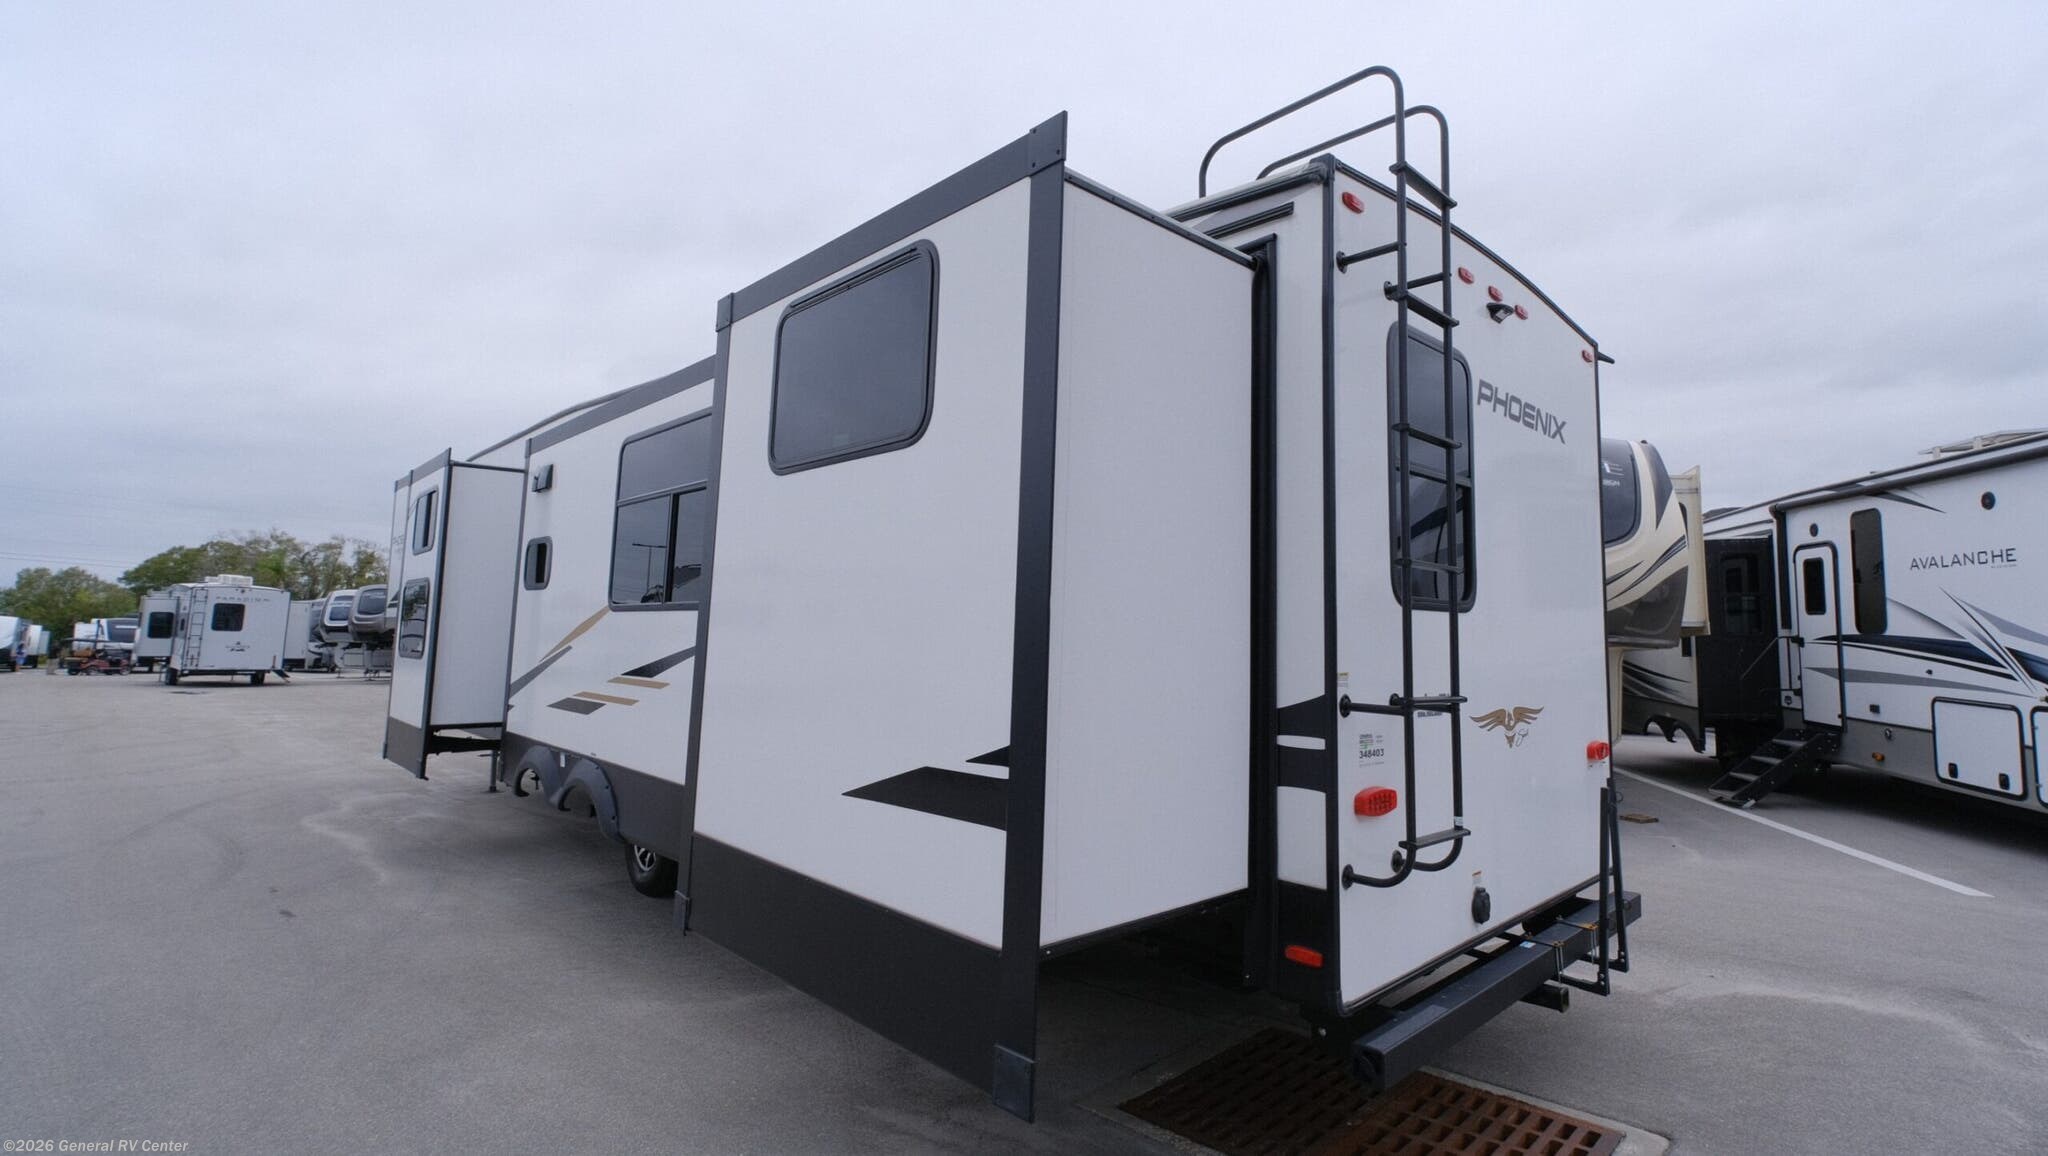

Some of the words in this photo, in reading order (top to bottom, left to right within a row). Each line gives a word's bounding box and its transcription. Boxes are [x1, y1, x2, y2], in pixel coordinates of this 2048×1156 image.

[1477, 379, 1566, 444] PHOENIX
[1910, 548, 2017, 570] AVALANCHE
[1359, 748, 1385, 759] 348403
